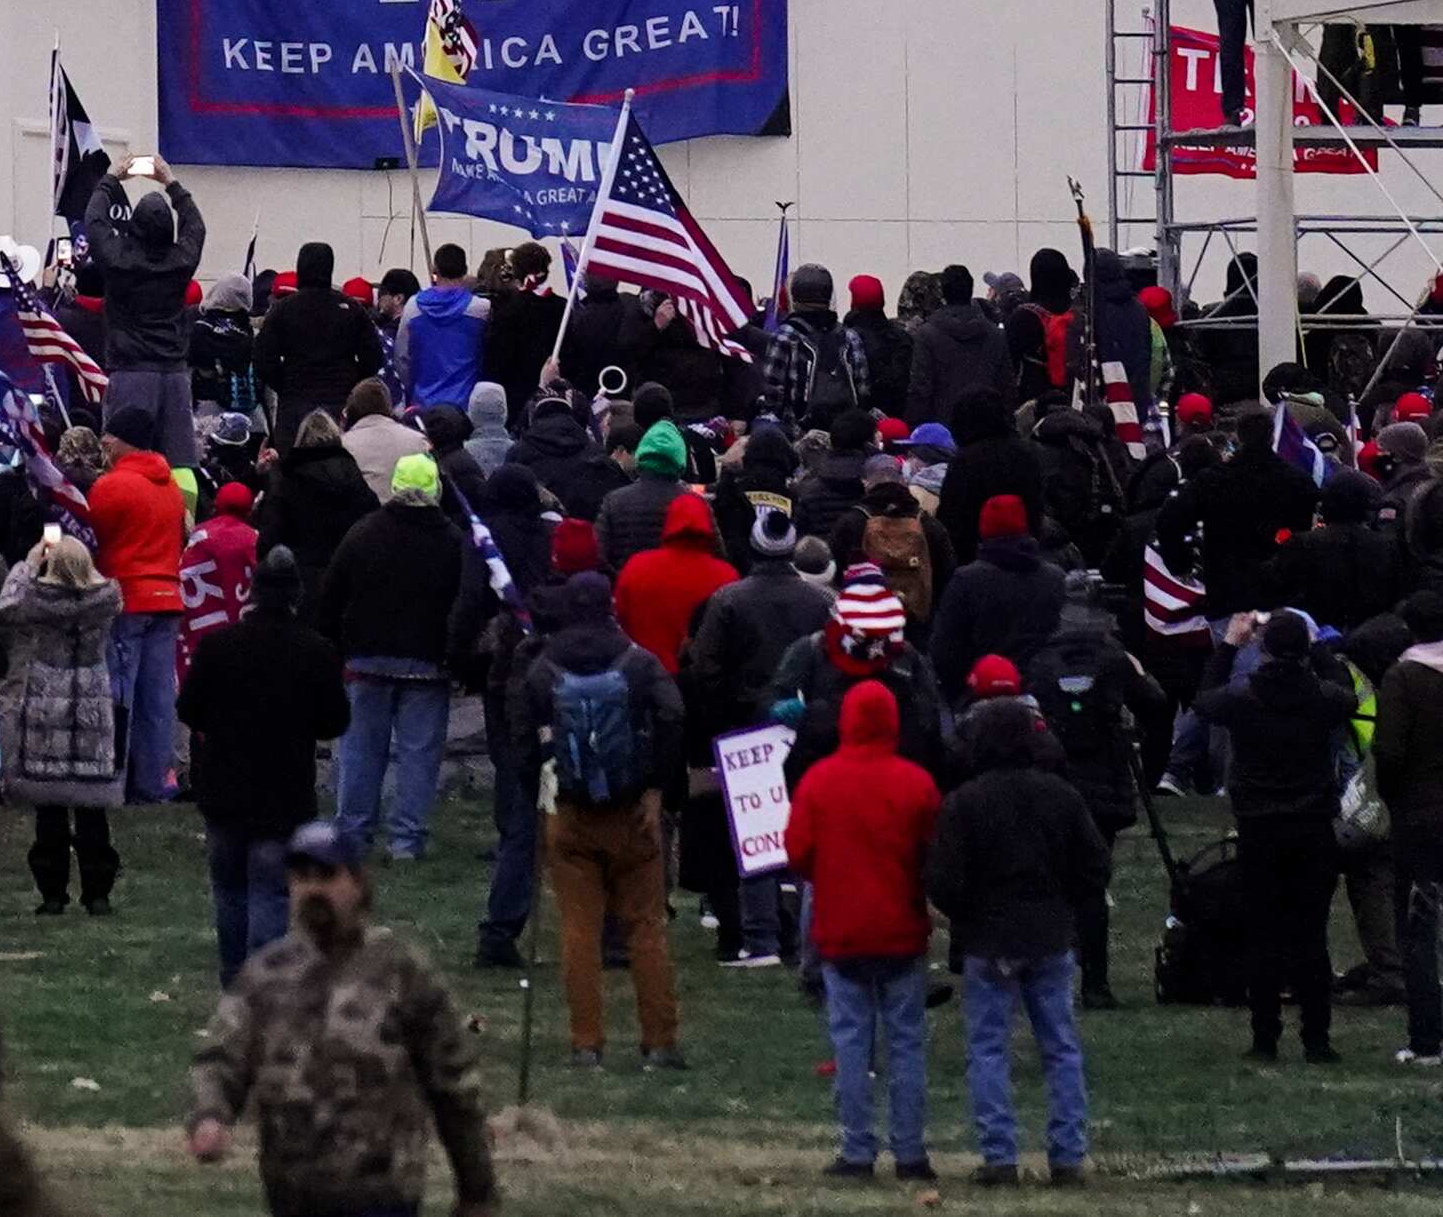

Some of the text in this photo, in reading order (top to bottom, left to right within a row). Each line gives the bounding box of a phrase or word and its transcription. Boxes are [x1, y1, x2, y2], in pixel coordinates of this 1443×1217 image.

[223, 4, 740, 75] KEEP AMICA GREAT!
[536, 187, 586, 206] GREAT
[724, 743, 774, 772] KEEP
[735, 792, 761, 814] TO
